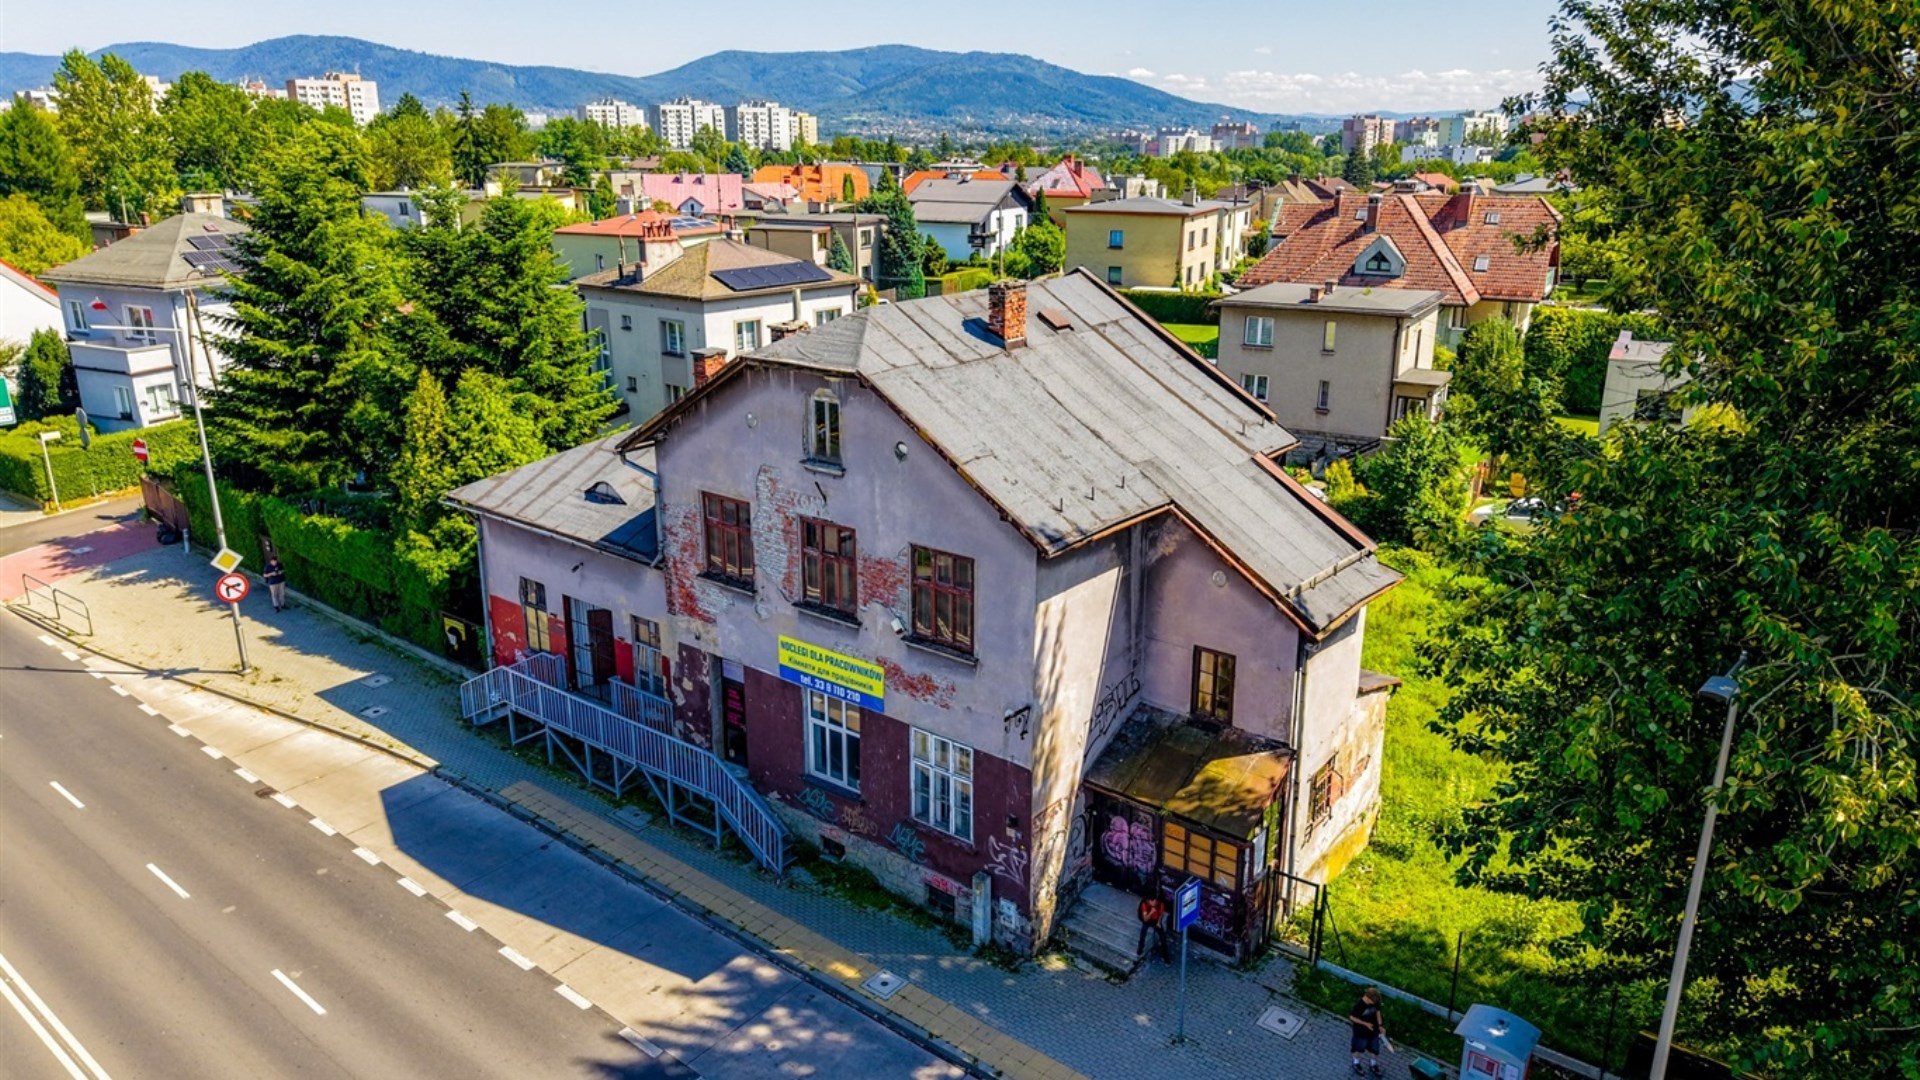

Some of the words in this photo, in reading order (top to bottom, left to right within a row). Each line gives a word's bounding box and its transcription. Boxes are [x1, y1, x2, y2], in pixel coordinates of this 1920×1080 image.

[780, 640, 809, 658] NOCLEGI
[810, 649, 824, 663] DLA
[824, 653, 882, 683] PRACOWNIKÓW
[817, 666, 830, 677] для
[800, 674, 814, 687] tel.
[814, 678, 825, 690] 33
[833, 684, 846, 698] 110
[846, 689, 861, 703] 210
